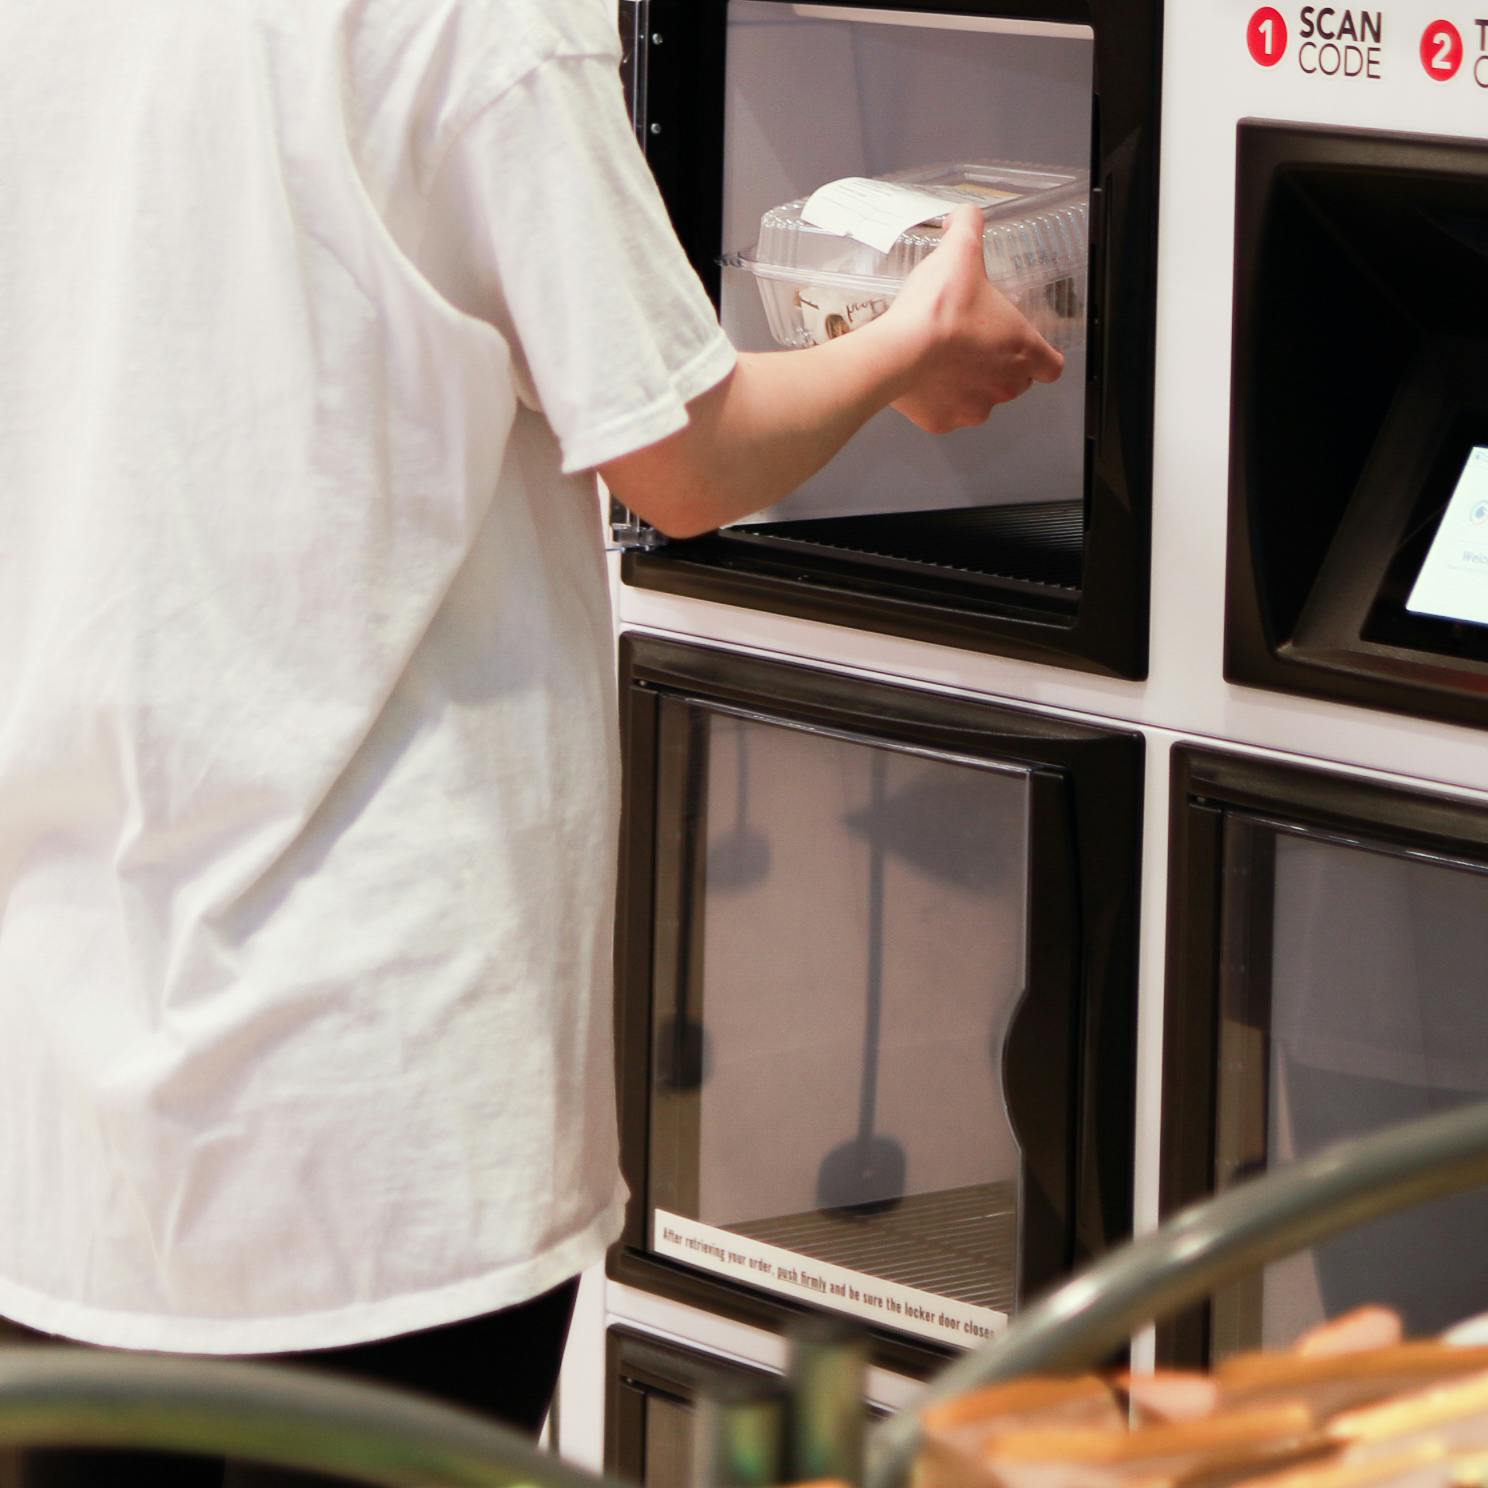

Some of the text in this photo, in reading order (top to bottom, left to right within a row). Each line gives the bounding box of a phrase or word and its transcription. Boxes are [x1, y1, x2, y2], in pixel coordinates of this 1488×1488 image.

[1258, 19, 1273, 55] 1
[1300, 5, 1383, 44] SCAN
[1298, 42, 1382, 79] CODE
[1431, 32, 1453, 71] 2
[663, 1226, 683, 1245] After
[685, 1237, 725, 1262] retrieving
[727, 1249, 746, 1265] your
[749, 1257, 776, 1276] order,
[777, 1264, 798, 1283] push
[800, 1271, 827, 1293] firmly
[830, 1282, 846, 1297] and
[849, 1285, 860, 1302] be
[863, 1292, 884, 1308] sure
[886, 1297, 902, 1314] the
[905, 1302, 935, 1323] locker
[938, 1312, 961, 1331] door
